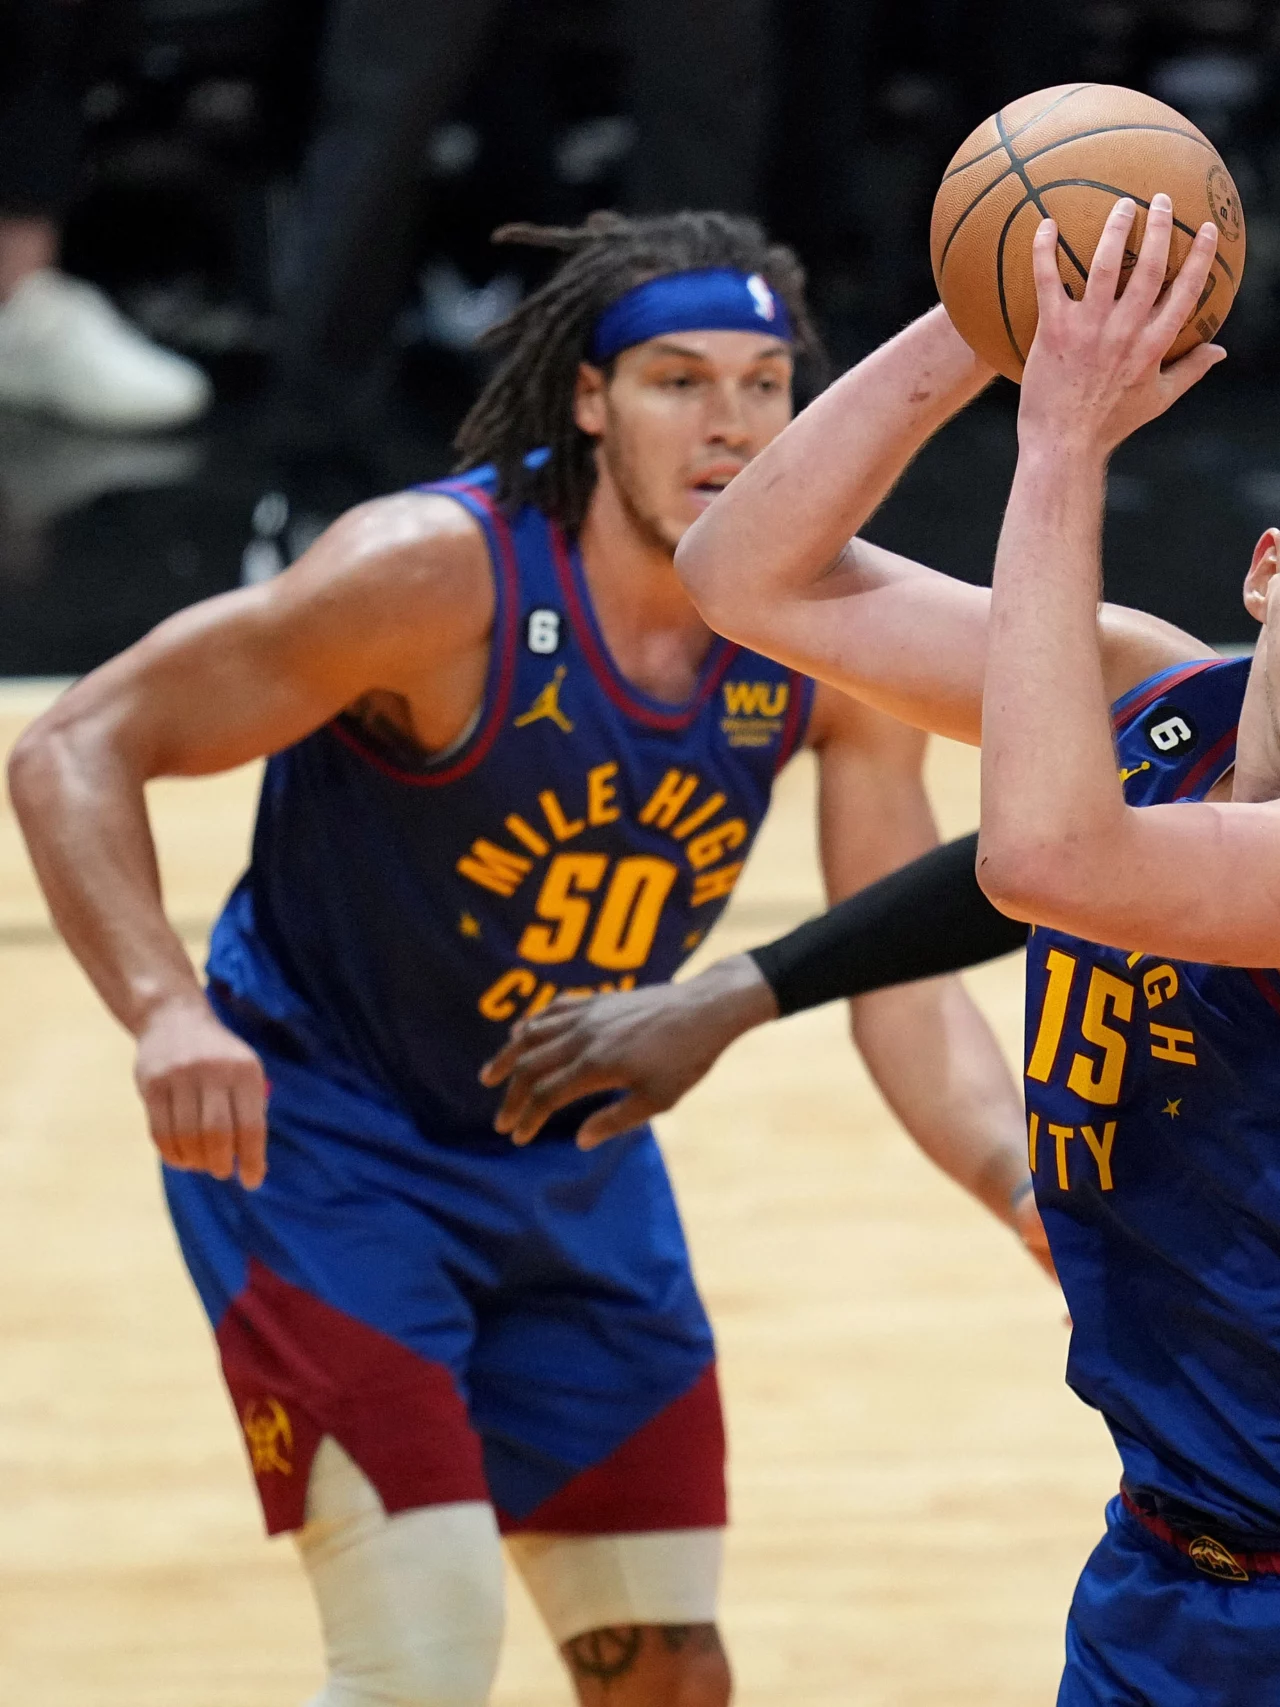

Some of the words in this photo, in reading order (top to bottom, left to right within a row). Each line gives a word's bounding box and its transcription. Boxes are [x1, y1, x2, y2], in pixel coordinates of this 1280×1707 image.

[528, 609, 559, 654] 6
[723, 681, 789, 717] WU
[1150, 715, 1191, 752] 6
[456, 762, 621, 898] MILE
[638, 768, 749, 907] HIGH
[517, 852, 679, 970] 50
[478, 967, 637, 1021] CI
[1026, 948, 1135, 1106] 15
